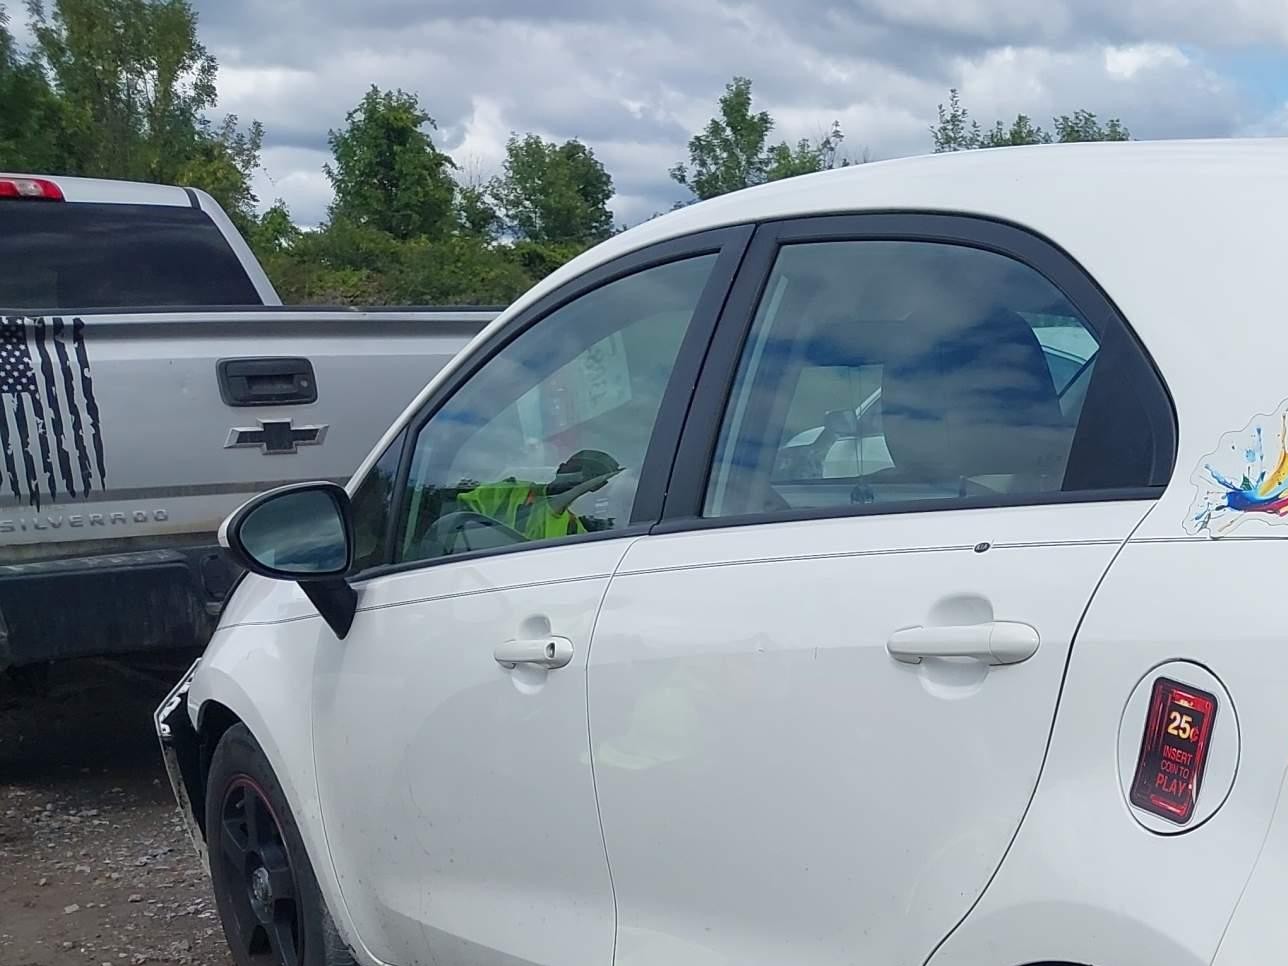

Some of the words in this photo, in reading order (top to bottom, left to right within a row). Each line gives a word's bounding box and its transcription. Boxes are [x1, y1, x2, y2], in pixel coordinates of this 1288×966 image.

[0, 509, 168, 533] SILVERADO
[1162, 745, 1193, 766] INSERT
[1160, 759, 1179, 775] COIN
[1177, 764, 1190, 779] TO
[1155, 774, 1186, 798] PLAY
